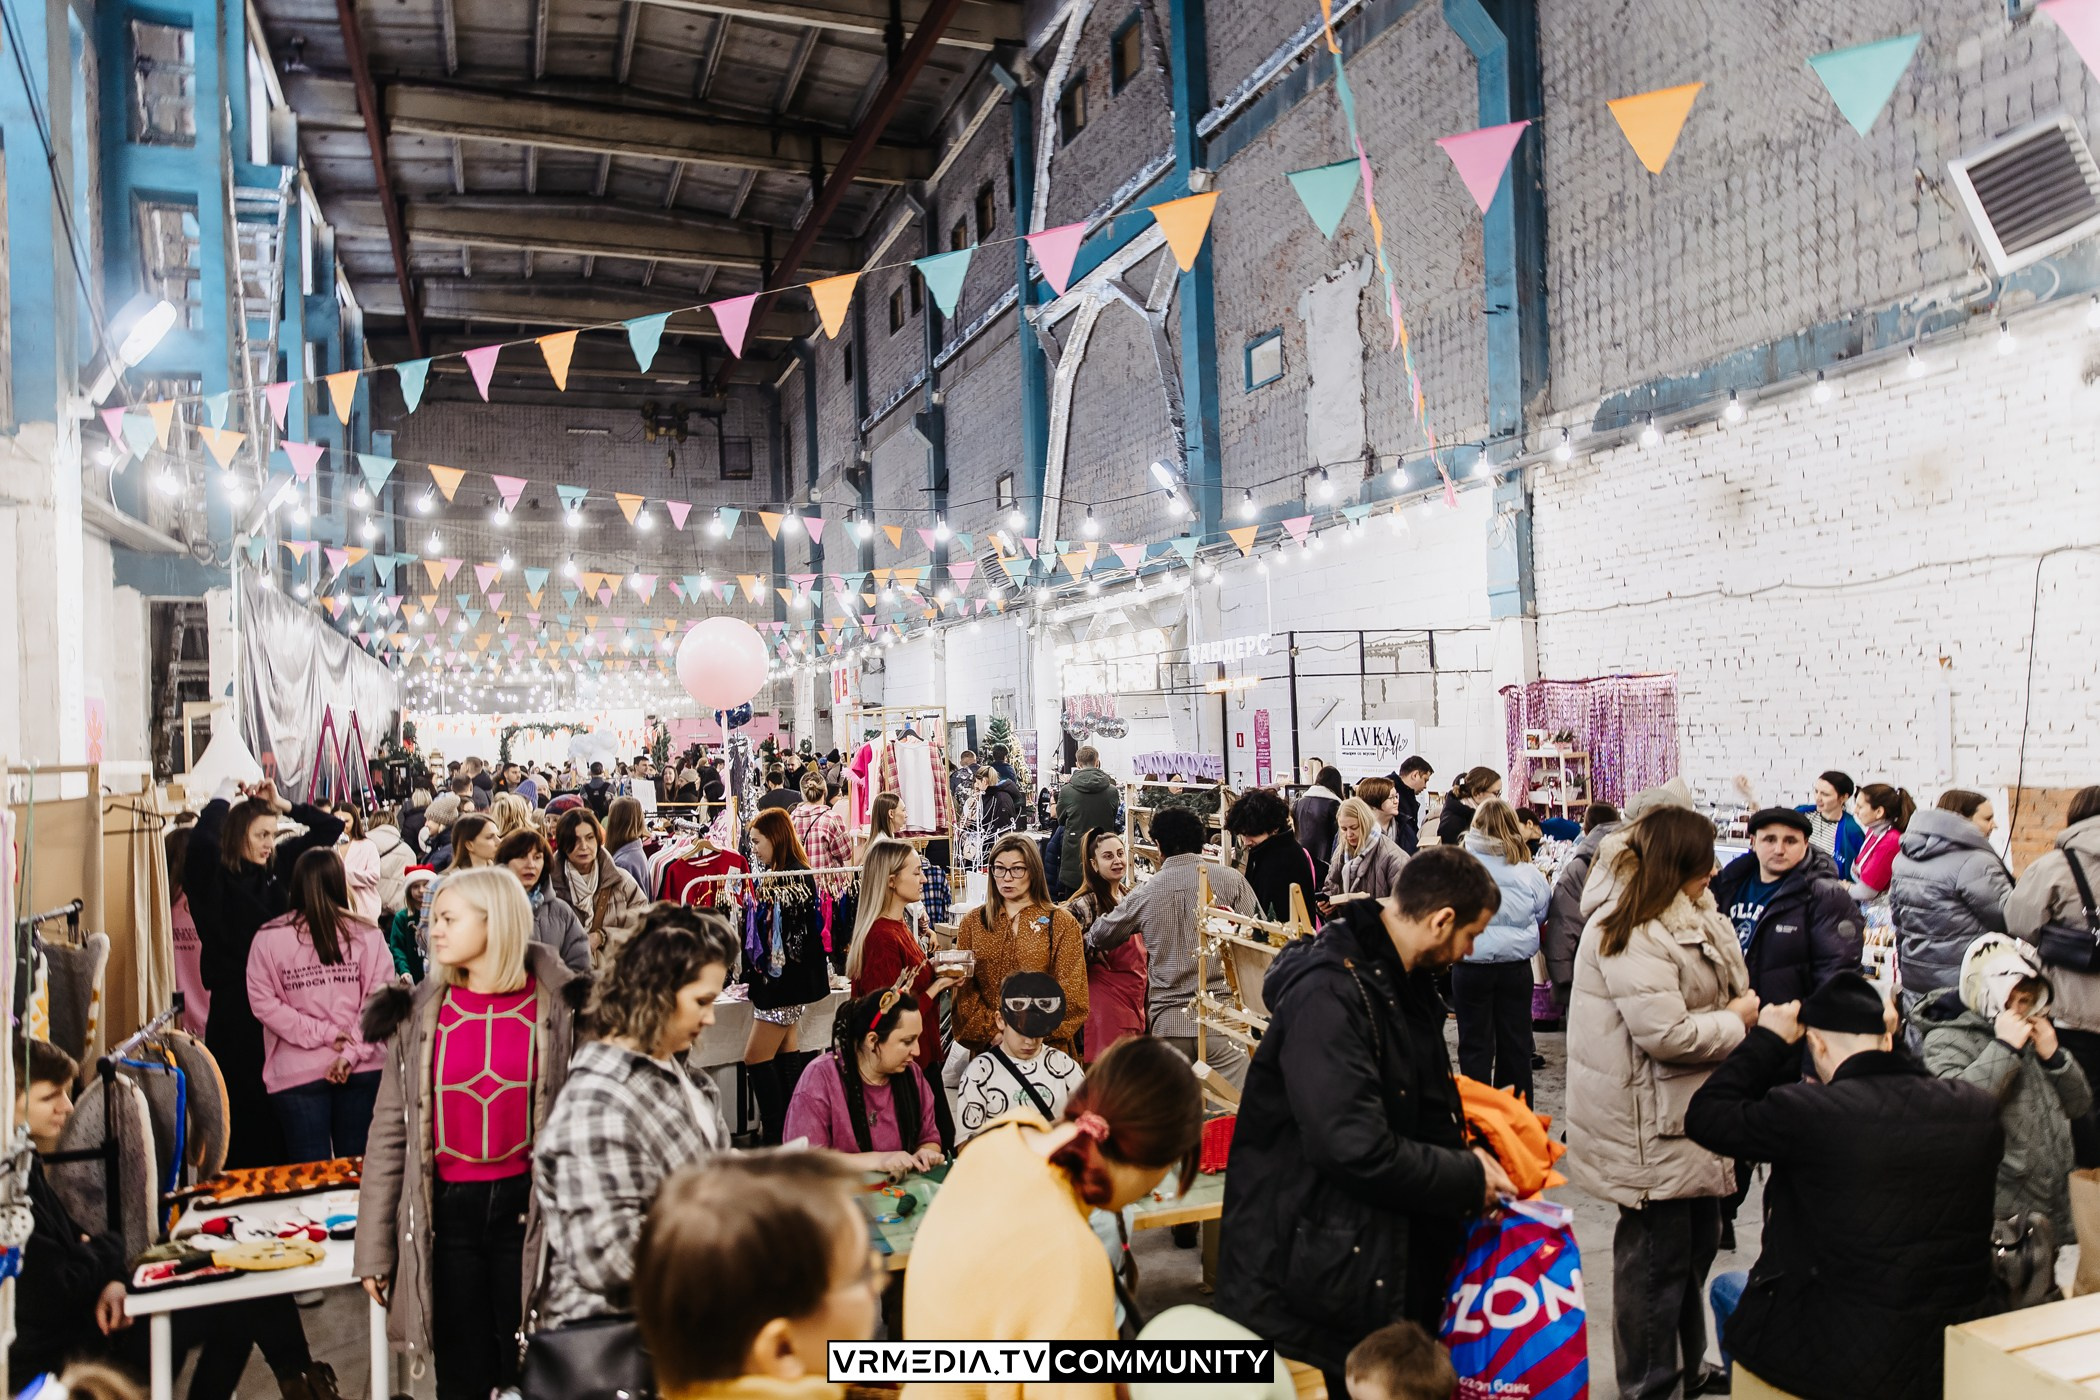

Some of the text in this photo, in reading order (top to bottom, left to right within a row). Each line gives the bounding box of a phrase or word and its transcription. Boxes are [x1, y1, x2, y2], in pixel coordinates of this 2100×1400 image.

[1188, 633, 1272, 665] ВАНДЕРС
[1341, 727, 1395, 746] LAVKA
[1439, 1268, 1586, 1334] ZON
